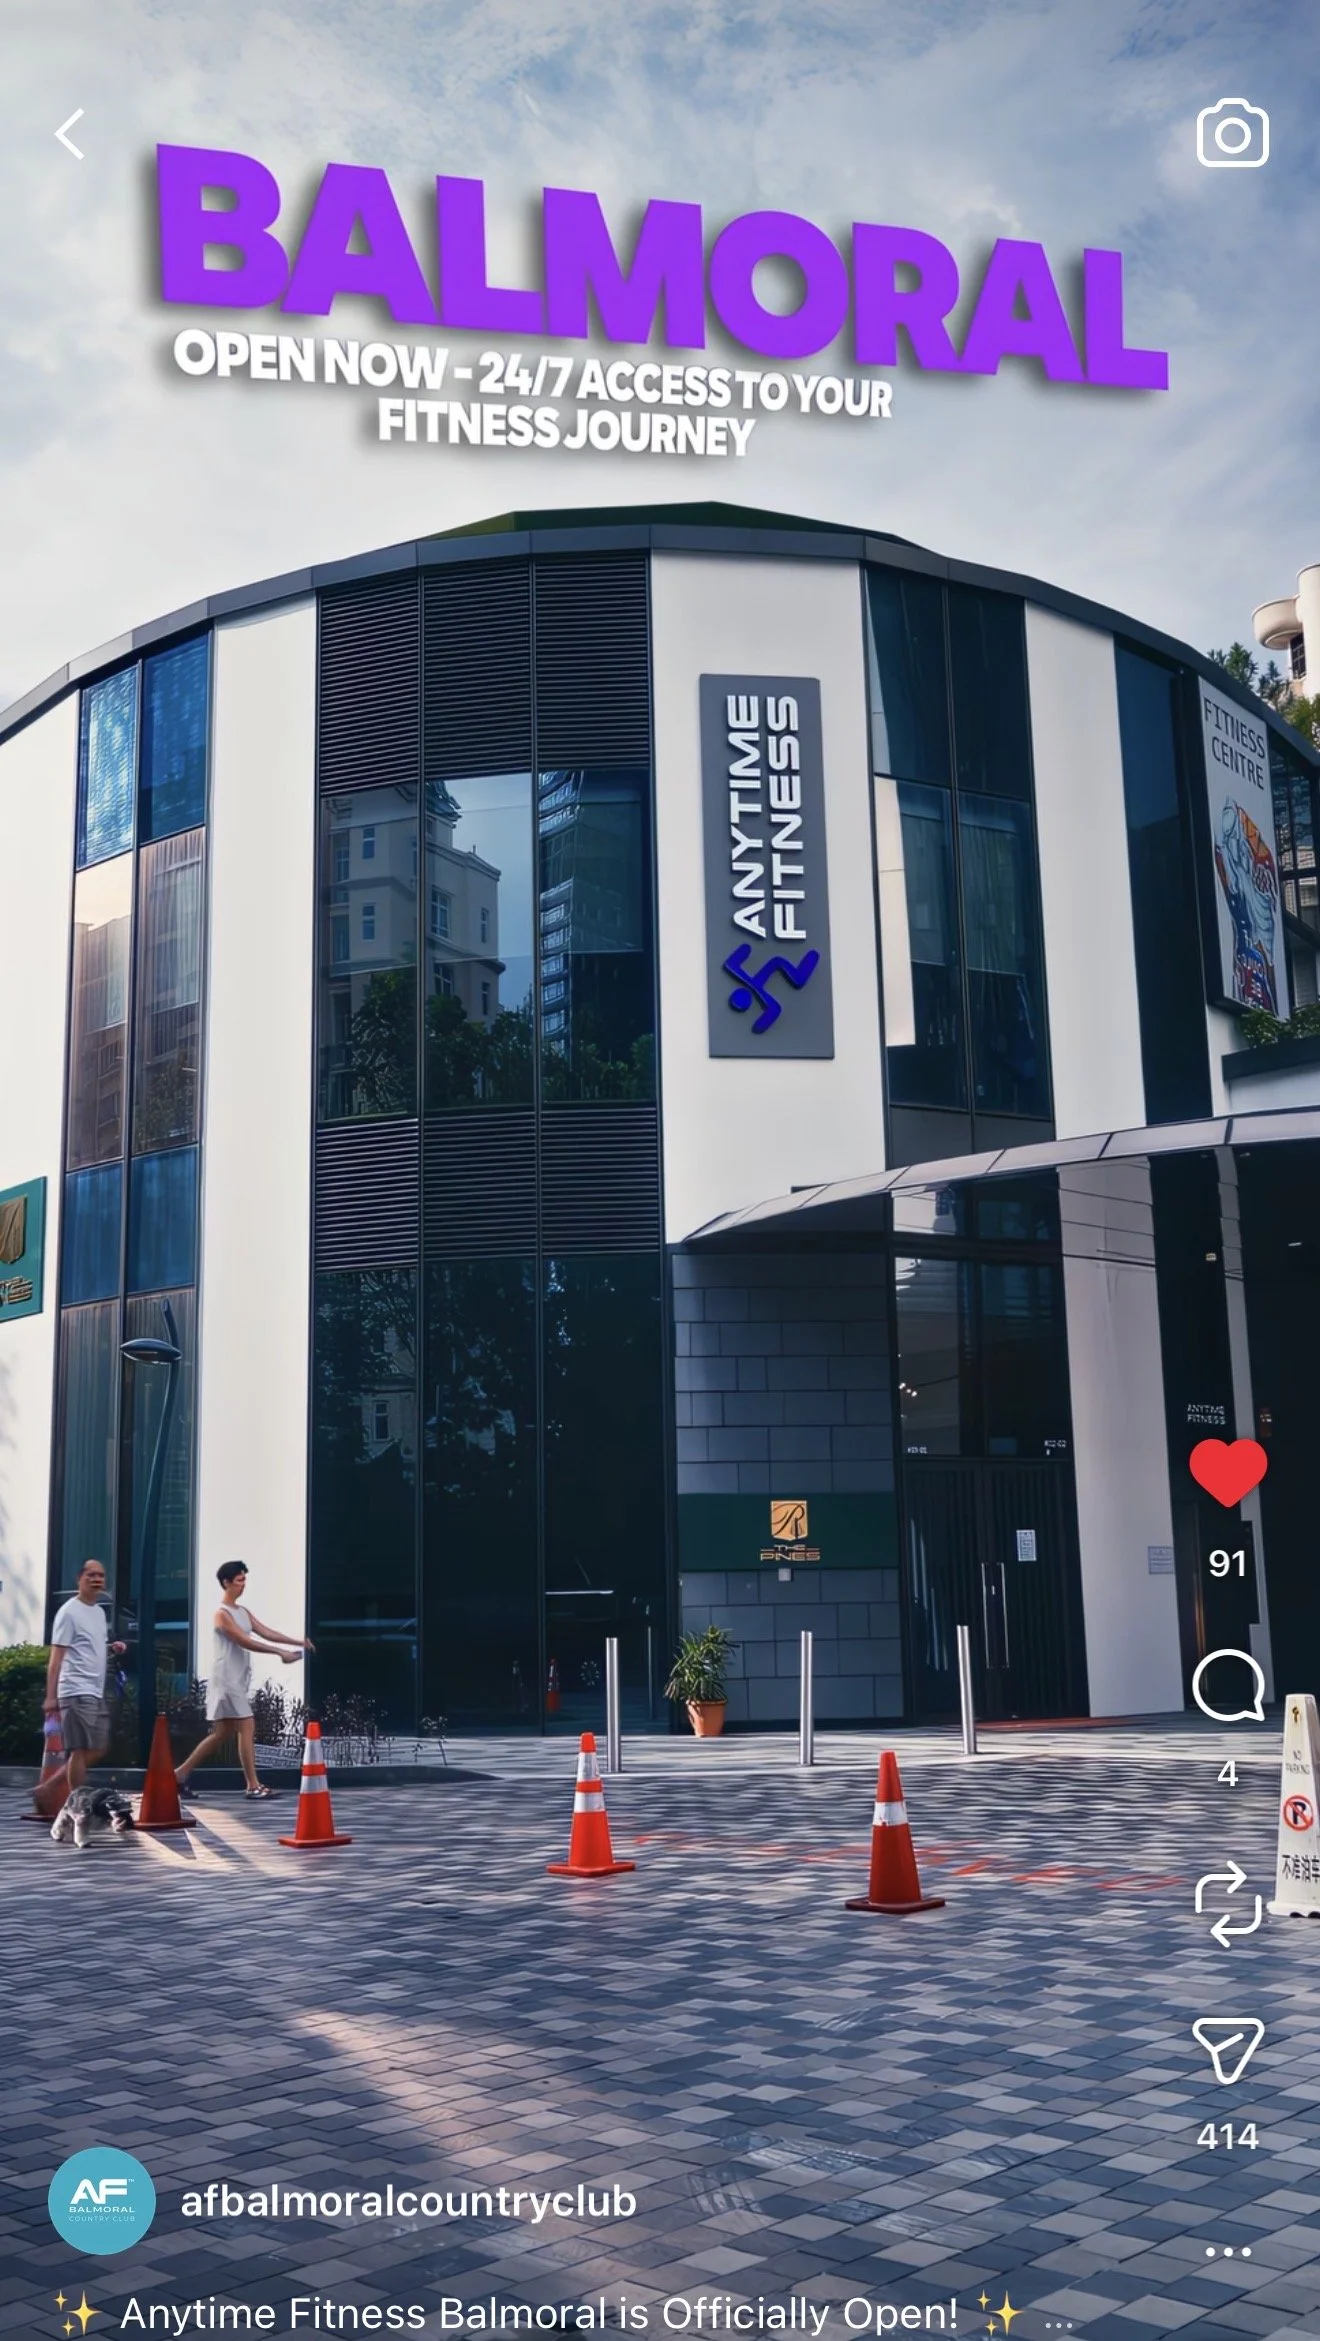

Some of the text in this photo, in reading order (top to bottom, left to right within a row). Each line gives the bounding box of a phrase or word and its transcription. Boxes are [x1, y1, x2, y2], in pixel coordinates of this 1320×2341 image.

[1203, 696, 1266, 760] FITNESS
[1211, 735, 1265, 791] CENTRE
[726, 694, 767, 939] ANYTIME
[766, 695, 807, 941] FITNESS
